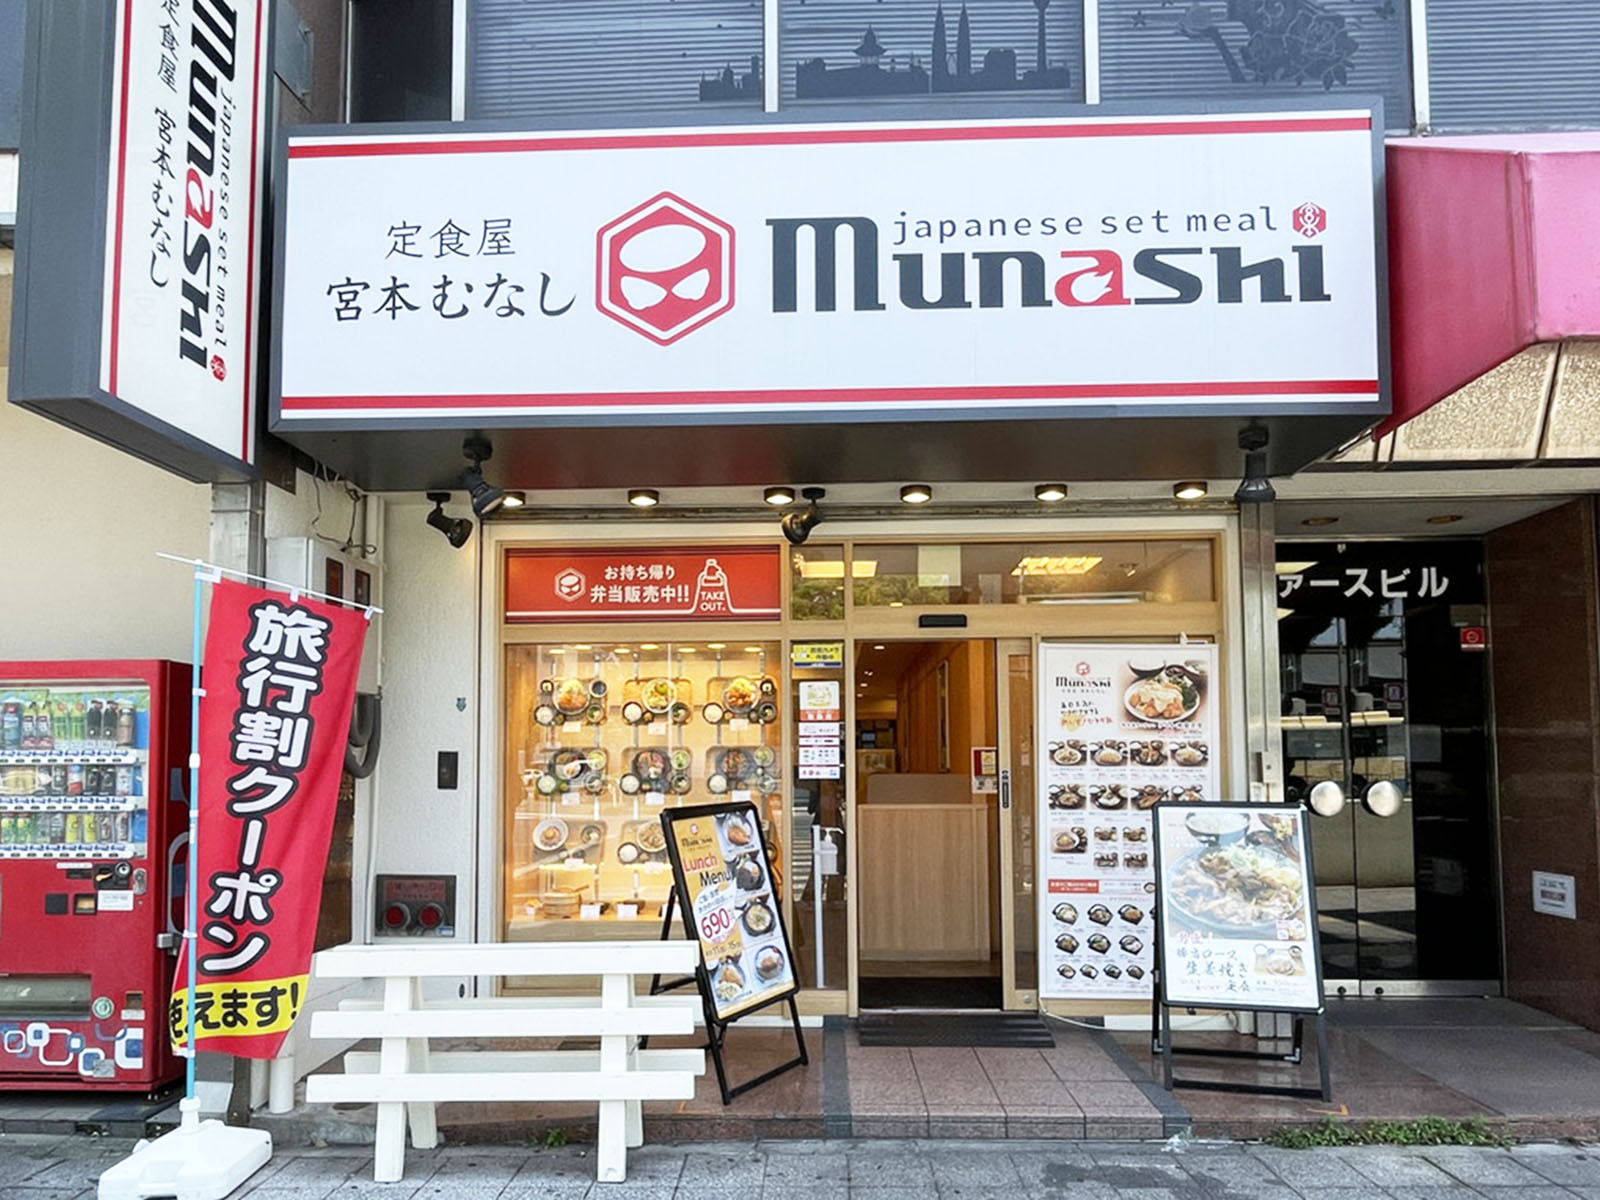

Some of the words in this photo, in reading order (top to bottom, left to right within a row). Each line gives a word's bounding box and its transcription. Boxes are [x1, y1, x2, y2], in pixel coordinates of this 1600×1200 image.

[219, 87, 236, 220] japanese
[150, 107, 178, 289] 宮本むなし
[386, 218, 516, 260] 定食屋
[892, 211, 1083, 246] japanese
[1100, 209, 1169, 235] set
[1186, 206, 1278, 233] meal
[217, 228, 229, 278] set
[214, 285, 227, 347] meal
[326, 272, 577, 321] 宮本むなし
[604, 565, 675, 581] お持ち帰り
[590, 585, 690, 604] 弁当販売中!!
[700, 591, 726, 601] TAKE
[201, 603, 330, 974] 旅行割クーポン
[683, 854, 718, 872] Lunch
[699, 869, 733, 888] Menu
[701, 907, 731, 939] 690
